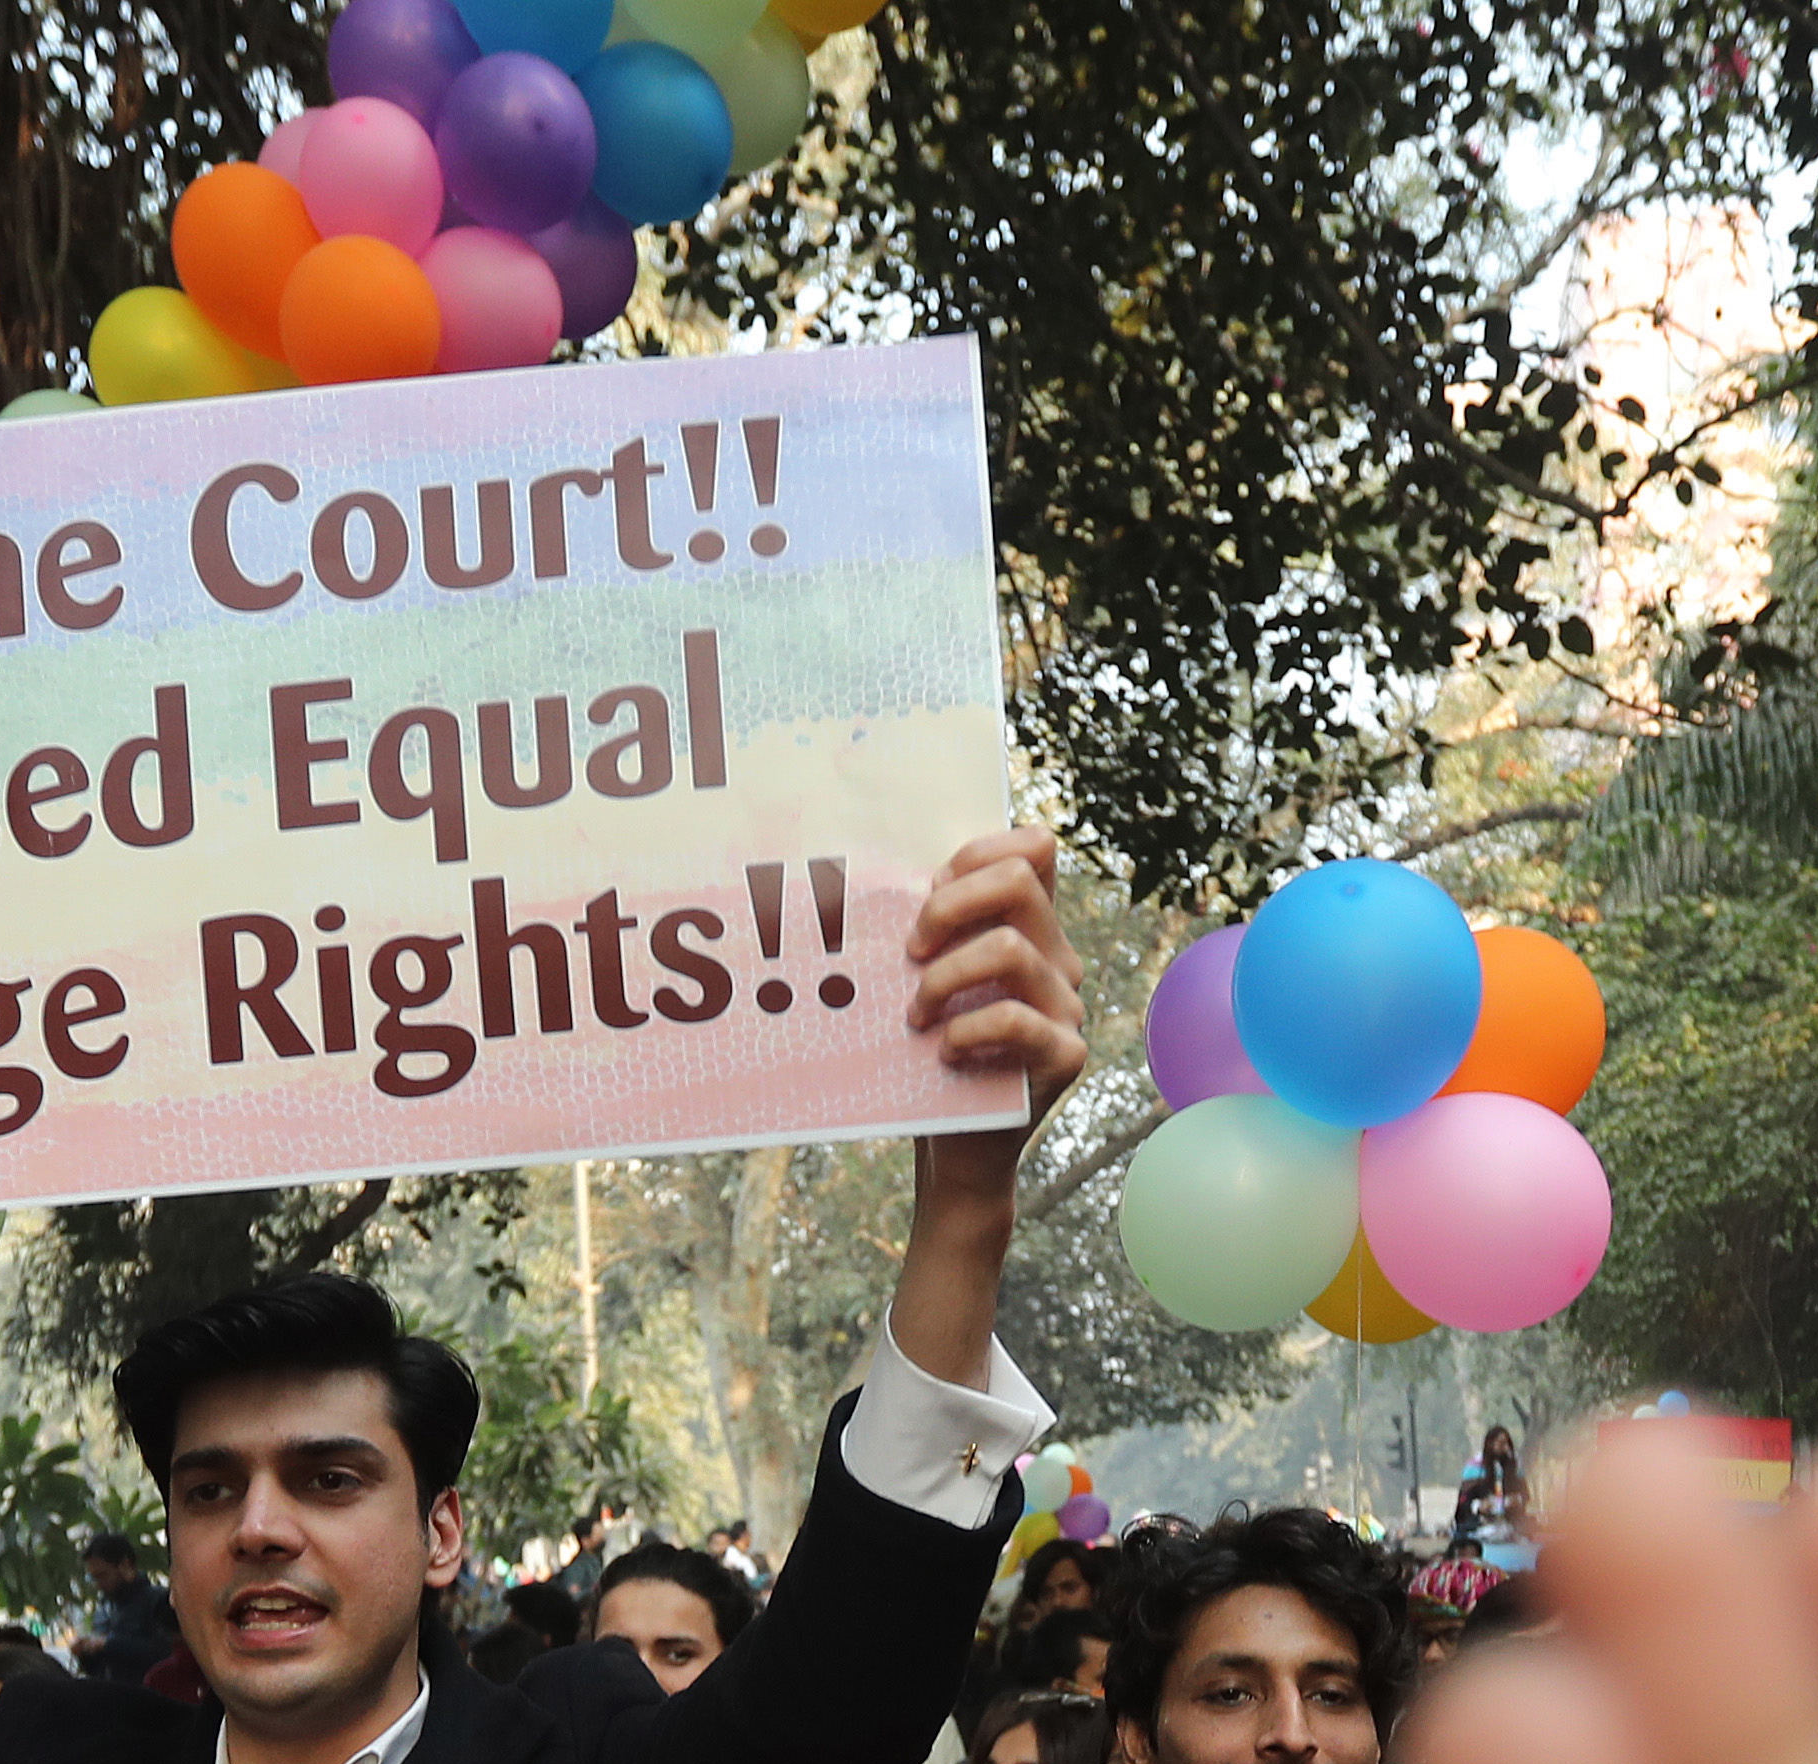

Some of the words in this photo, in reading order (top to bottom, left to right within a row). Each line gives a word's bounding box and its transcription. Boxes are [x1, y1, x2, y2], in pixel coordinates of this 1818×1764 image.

[190, 417, 789, 613] Court!!
[270, 630, 728, 864] Equal
[200, 858, 857, 1099] Rights!!
